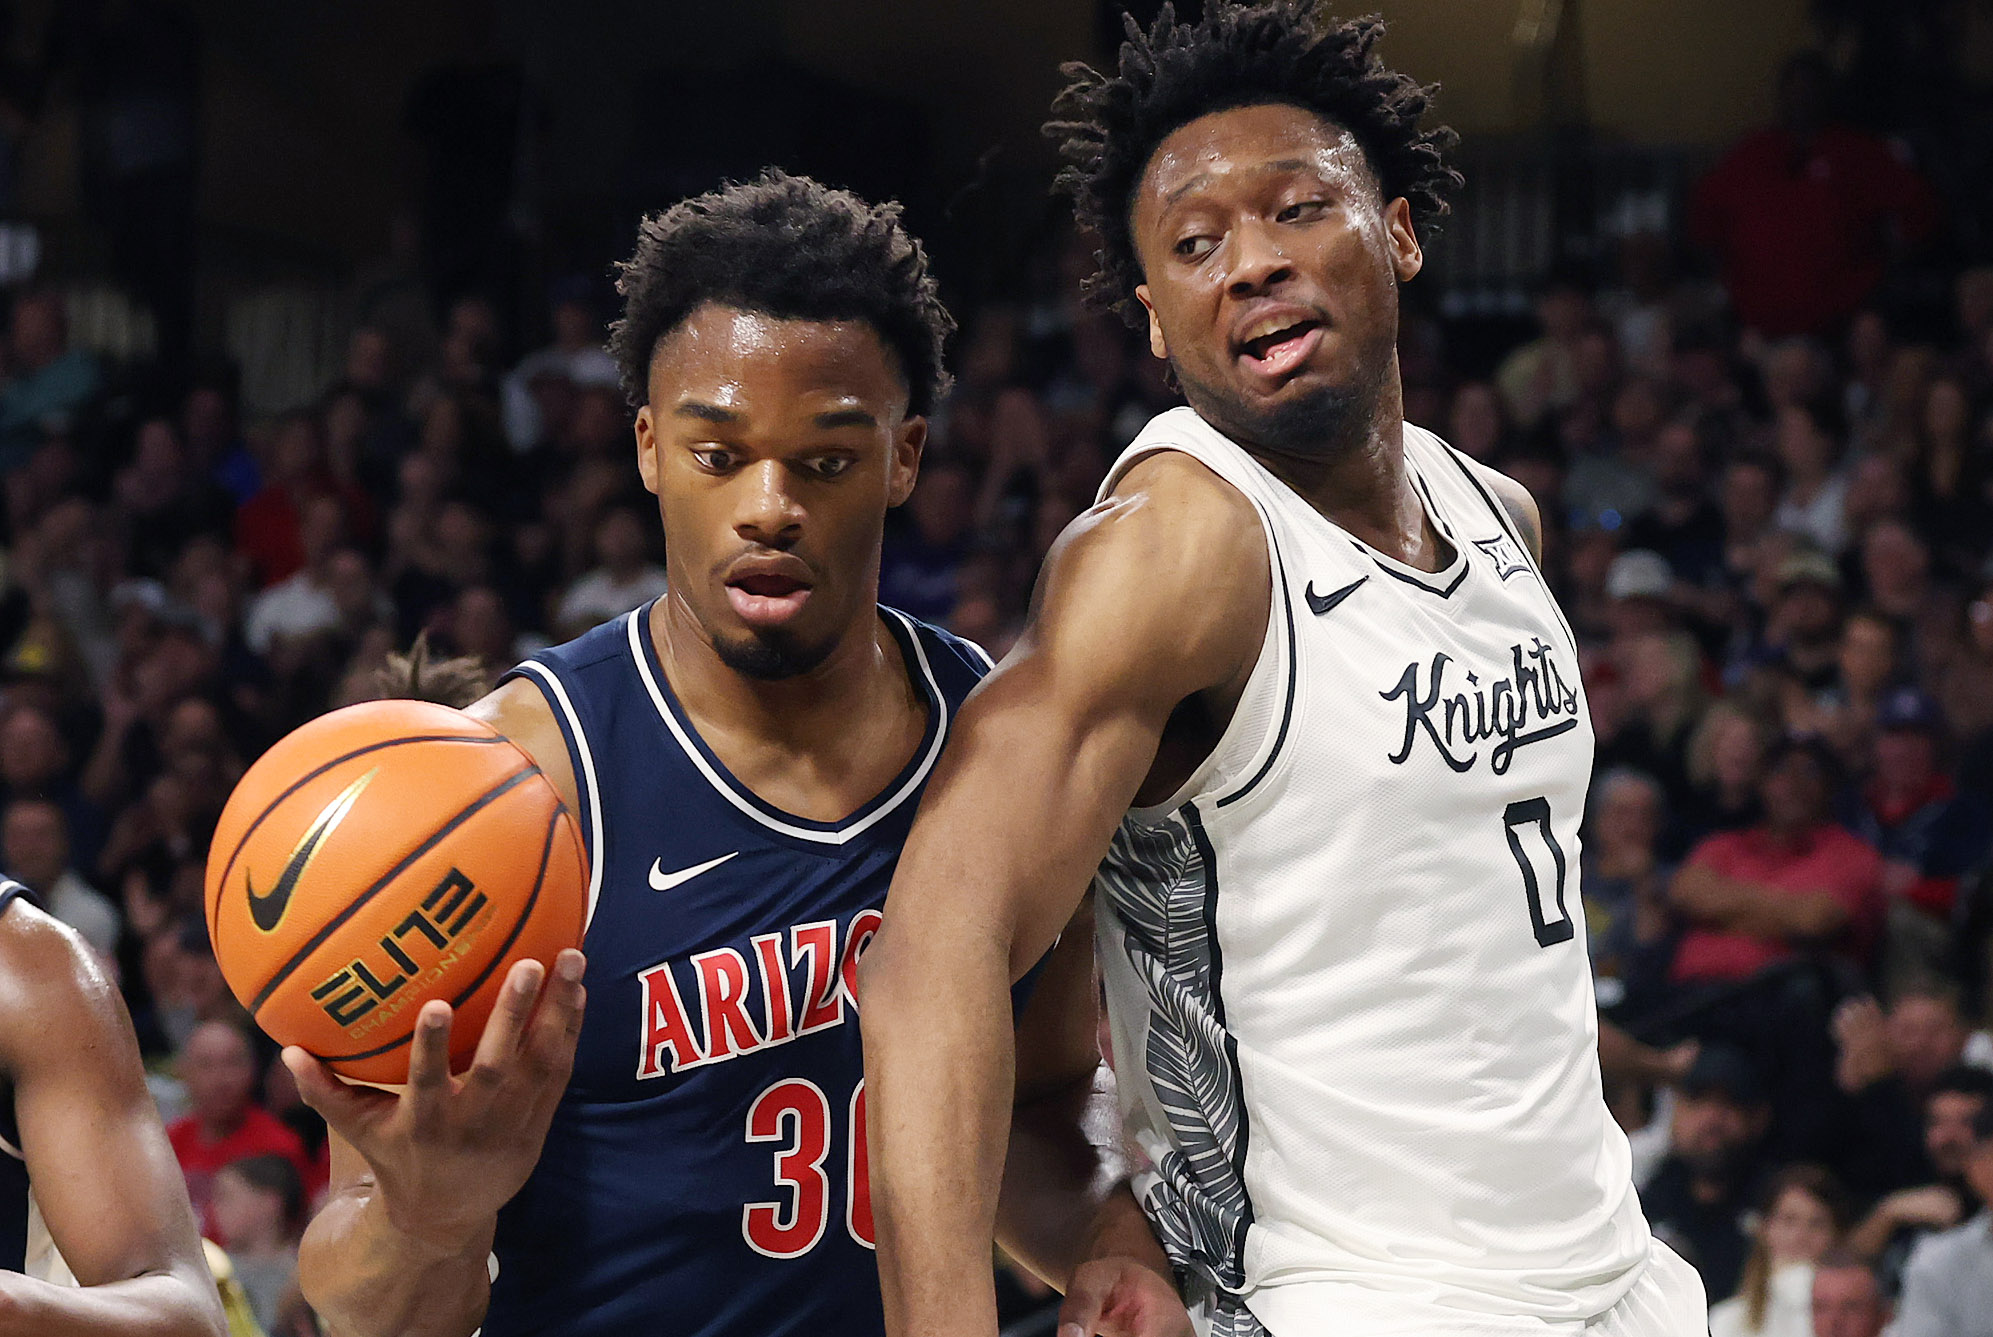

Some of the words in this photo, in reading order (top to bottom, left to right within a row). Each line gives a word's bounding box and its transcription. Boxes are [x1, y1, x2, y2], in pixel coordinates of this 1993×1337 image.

[1379, 638, 1578, 775] Knights
[310, 866, 488, 1027] ELITE
[1502, 797, 1574, 948] 0
